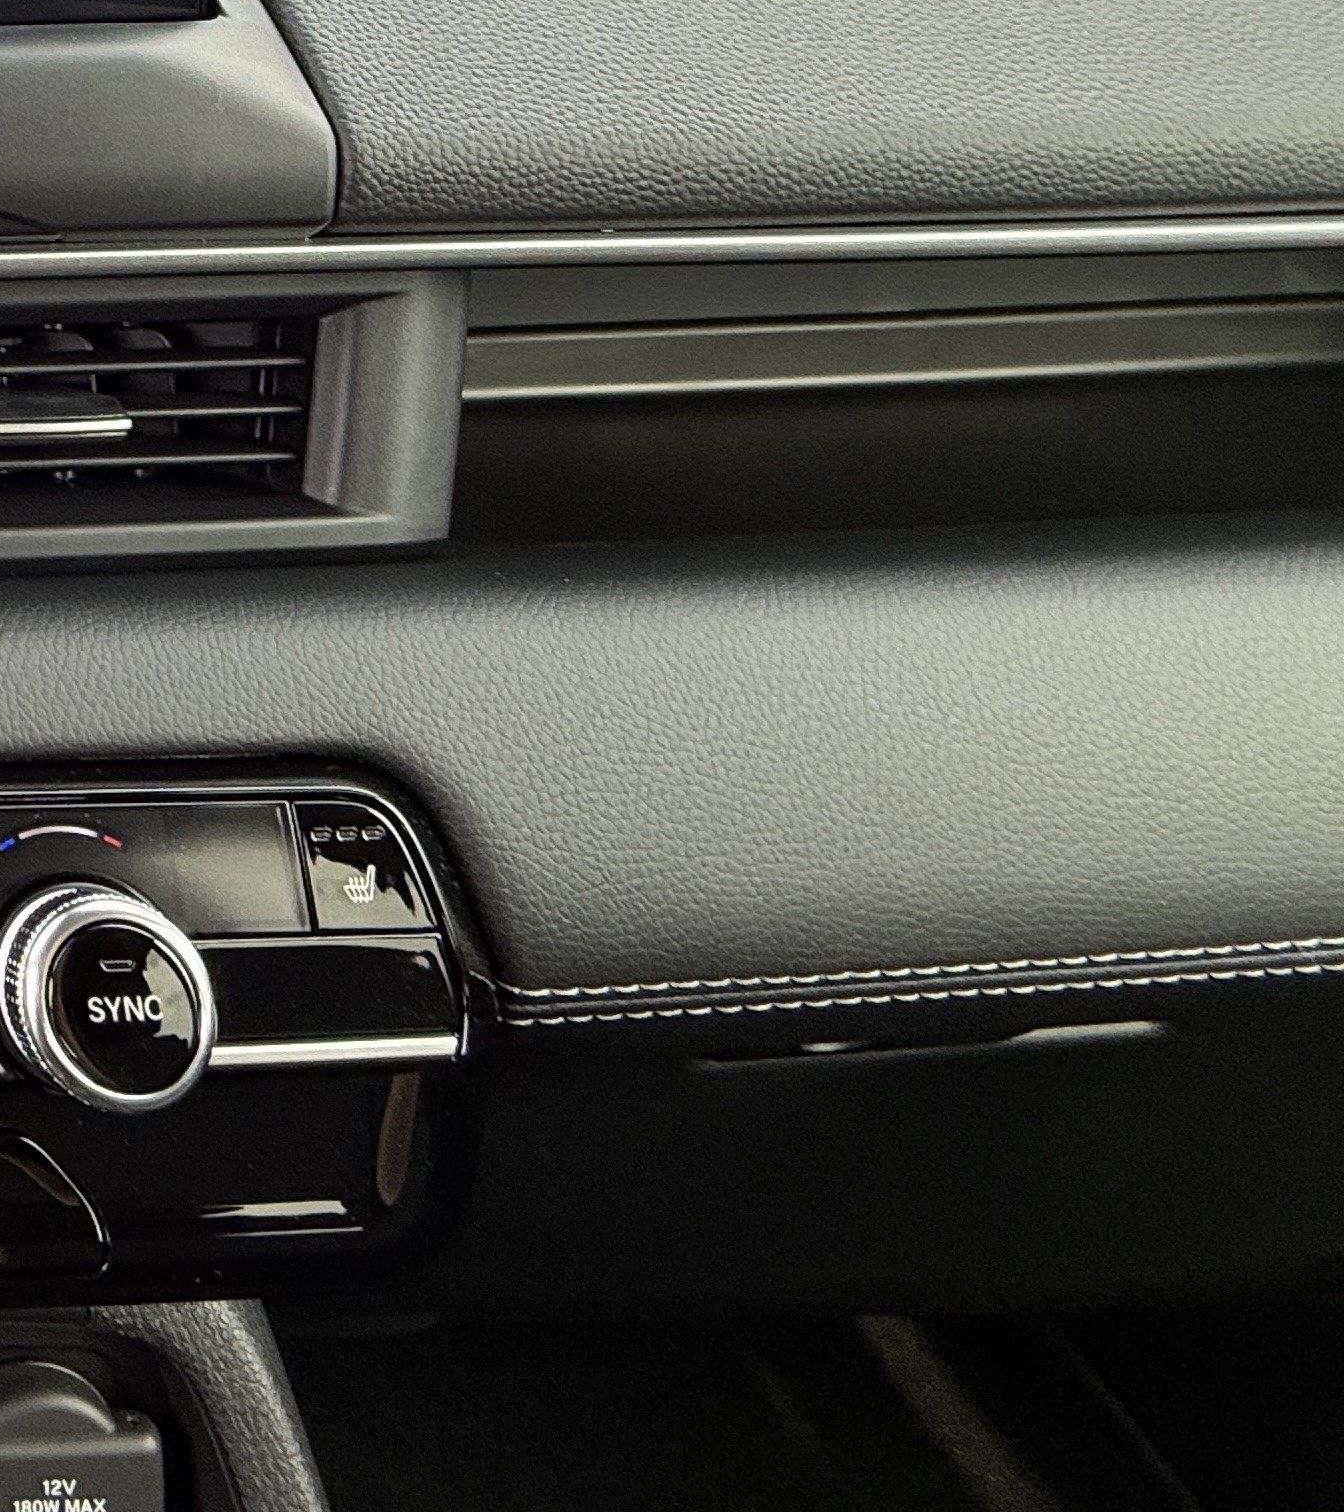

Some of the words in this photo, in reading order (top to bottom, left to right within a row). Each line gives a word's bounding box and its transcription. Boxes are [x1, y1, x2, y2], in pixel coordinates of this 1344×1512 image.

[87, 995, 164, 1023] SYNC
[42, 1478, 78, 1496] 12V
[13, 1499, 60, 1512] 180W
[64, 1498, 108, 1512] MAX
